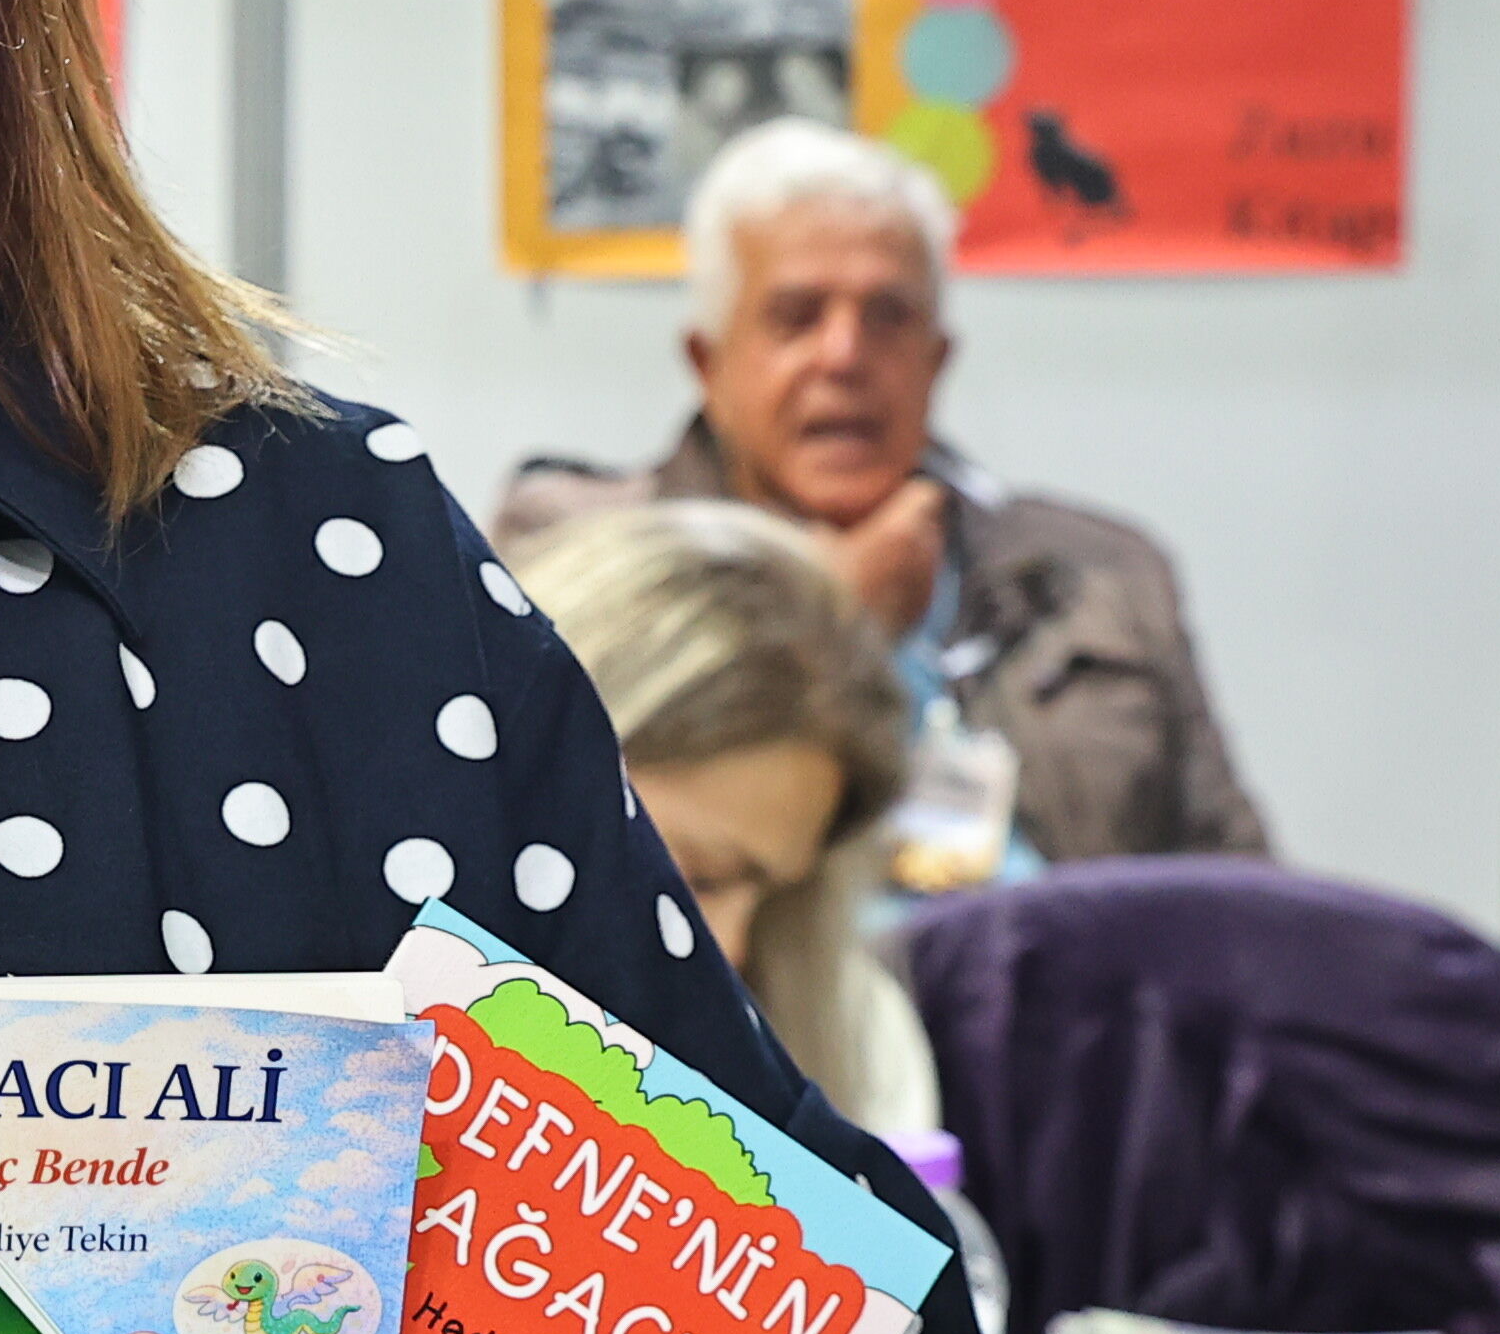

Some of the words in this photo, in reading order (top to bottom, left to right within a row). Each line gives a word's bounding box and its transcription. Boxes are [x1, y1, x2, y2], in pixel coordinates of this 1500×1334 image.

[145, 1048, 288, 1123] ALİ
[31, 1147, 170, 1187] Bende
[59, 1223, 148, 1253] Tekin
